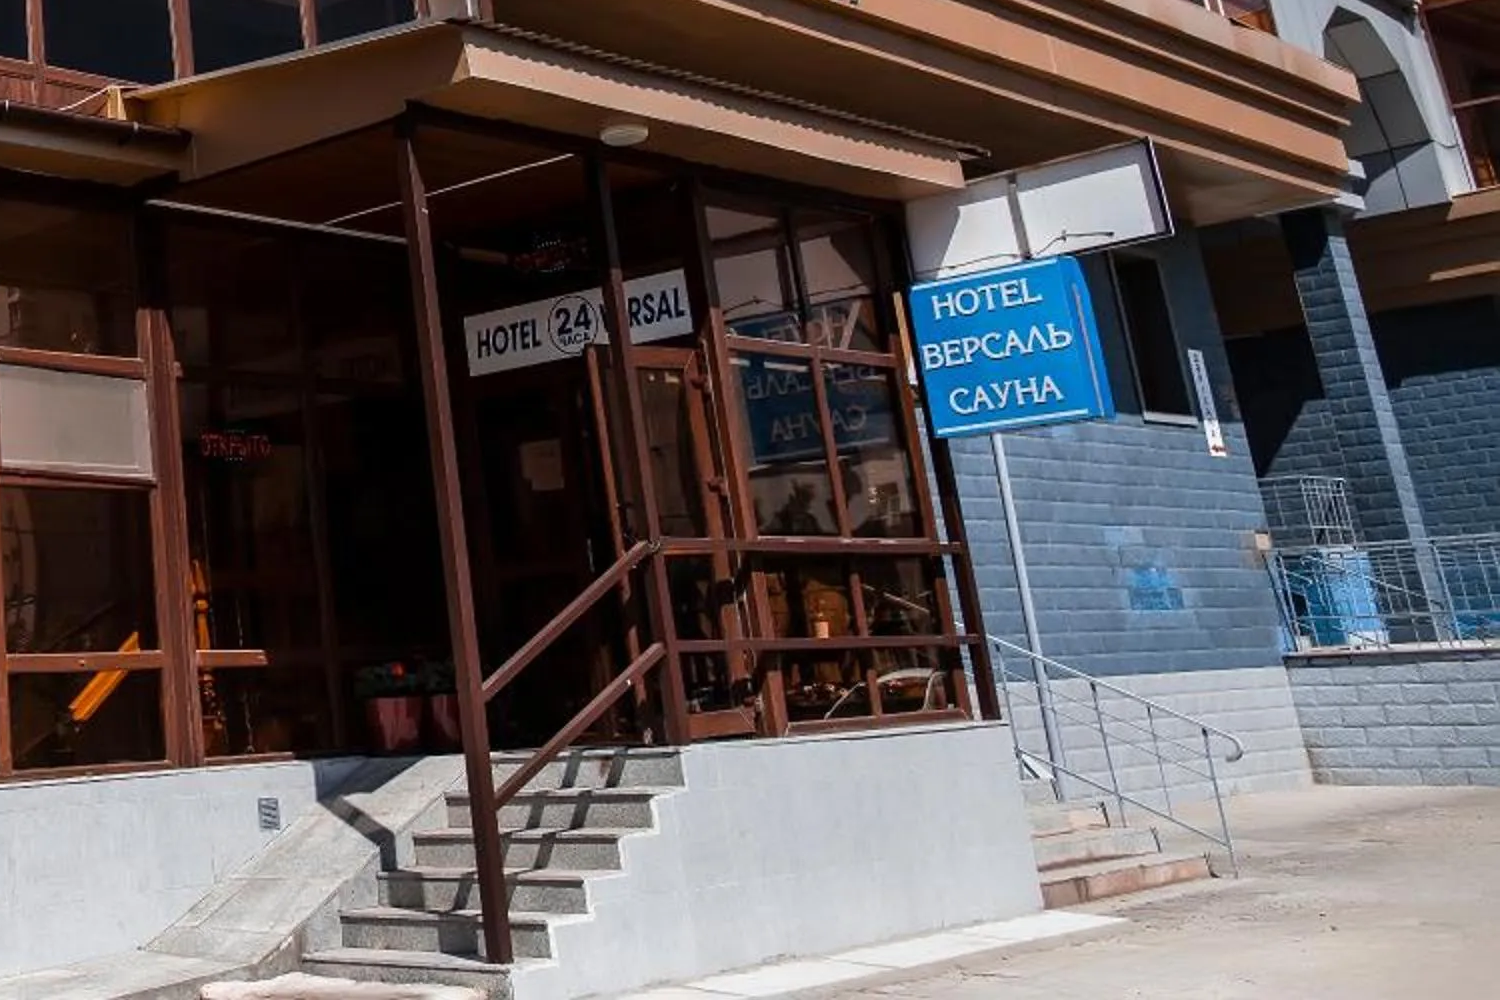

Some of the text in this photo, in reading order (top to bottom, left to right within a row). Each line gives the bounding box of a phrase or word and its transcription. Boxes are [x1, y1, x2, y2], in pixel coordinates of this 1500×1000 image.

[556, 304, 591, 335] 24
[933, 278, 1043, 320] HOTEL
[477, 286, 686, 358] HOTEL RSAL
[923, 323, 1074, 370] ВЕРСАЛЬ
[949, 375, 1064, 414] САУНА
